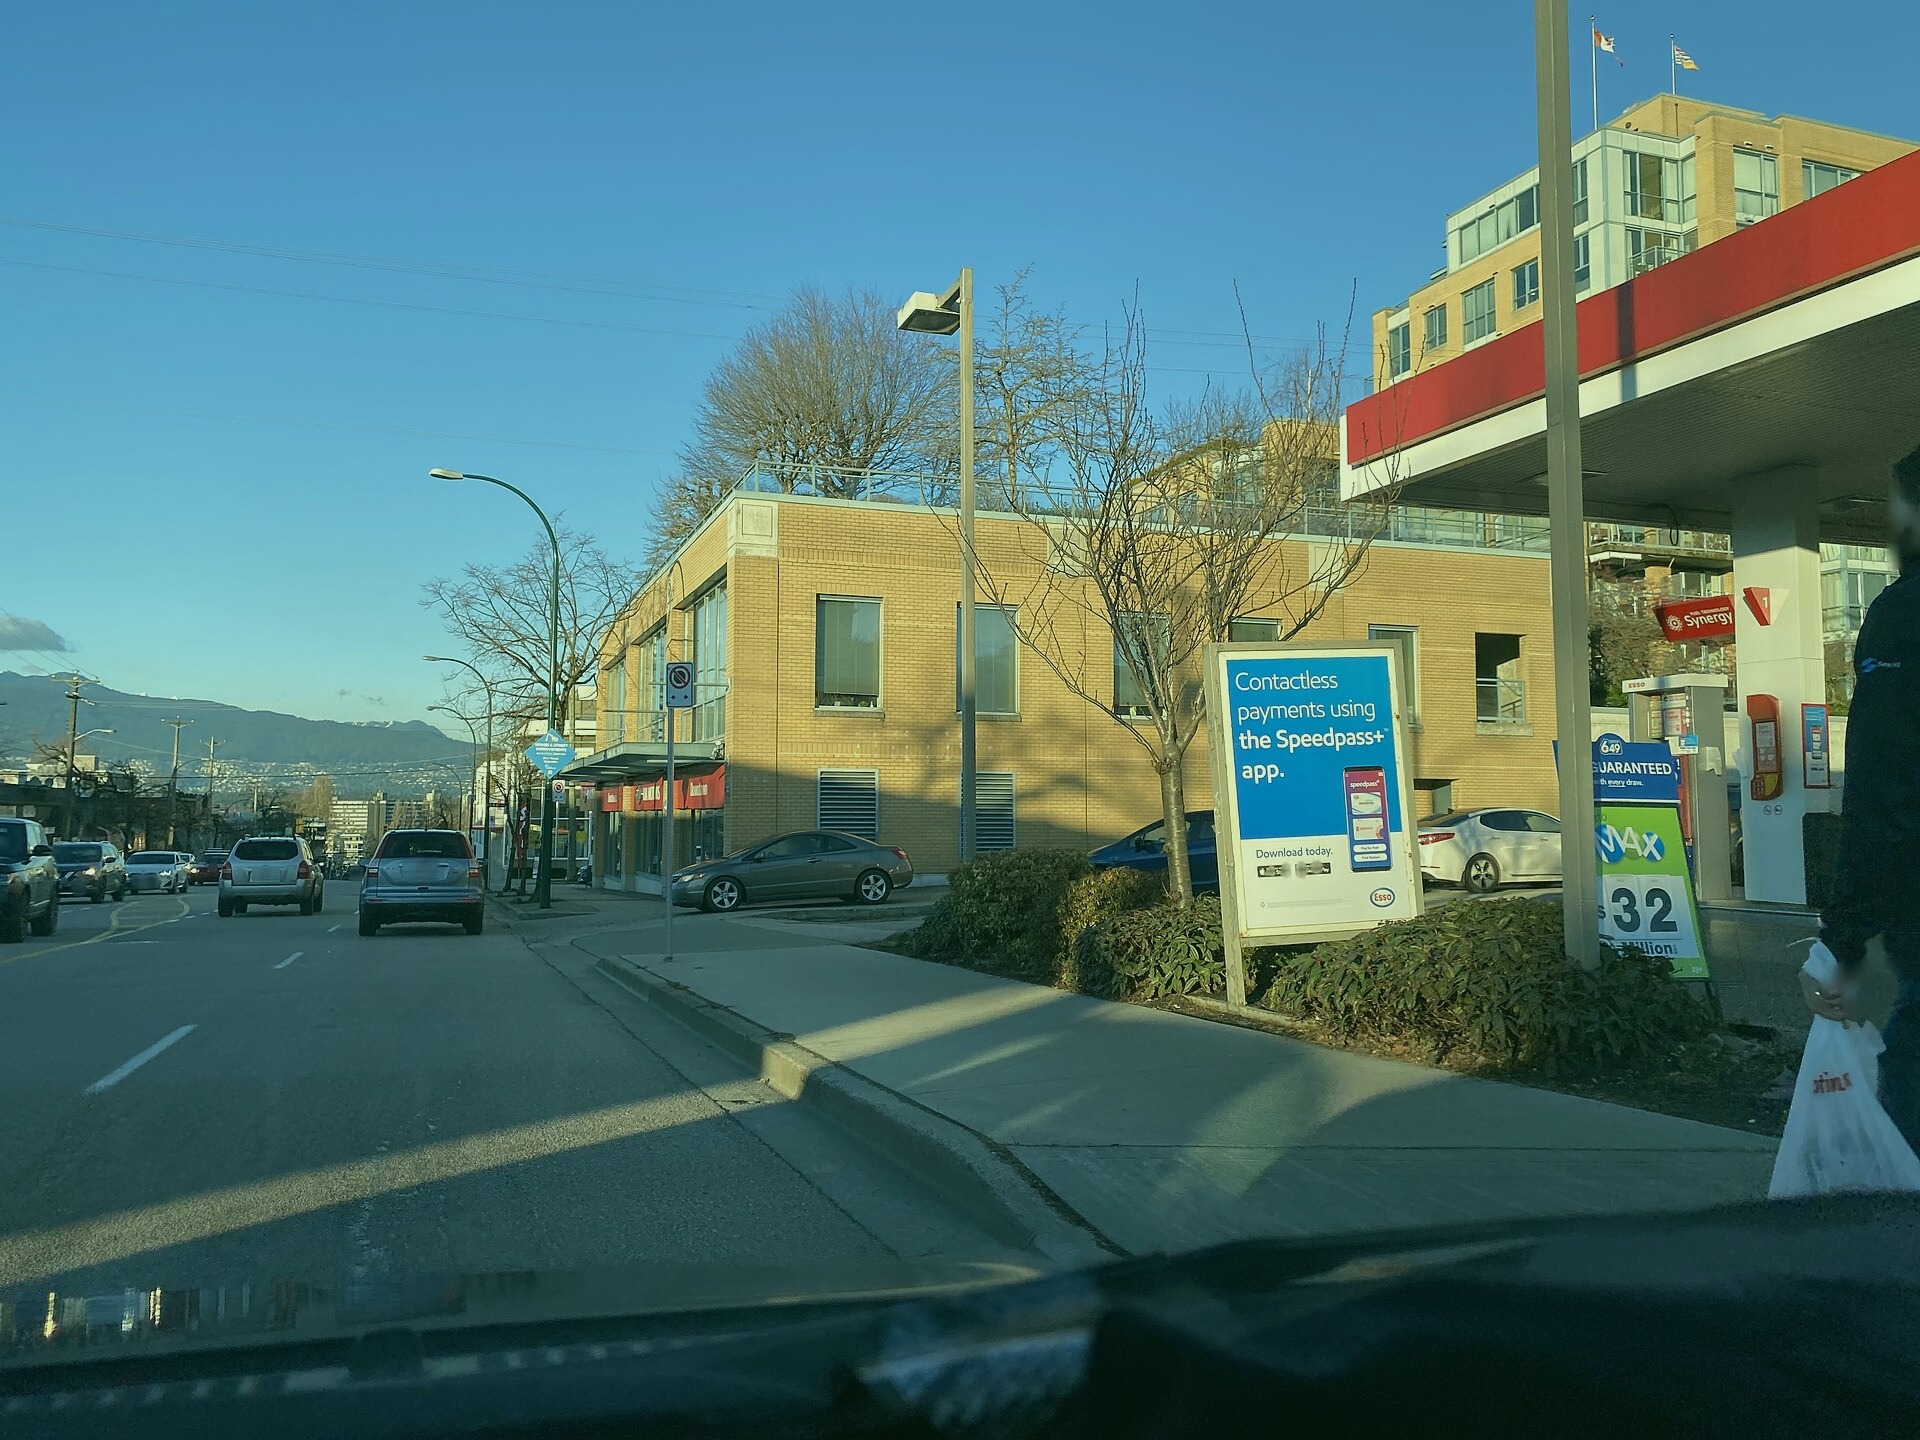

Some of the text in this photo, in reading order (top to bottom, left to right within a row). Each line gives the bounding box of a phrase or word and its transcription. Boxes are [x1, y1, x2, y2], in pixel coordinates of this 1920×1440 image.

[1762, 596, 1769, 608] 1
[1684, 612, 1733, 628] Synergy
[1235, 670, 1338, 691] Contactless
[1237, 699, 1376, 725] payments using
[1239, 730, 1271, 750] the
[1242, 763, 1285, 784] app.
[1256, 846, 1333, 859] Download today.
[1374, 893, 1392, 902] Esso
[1613, 888, 1678, 932] 32
